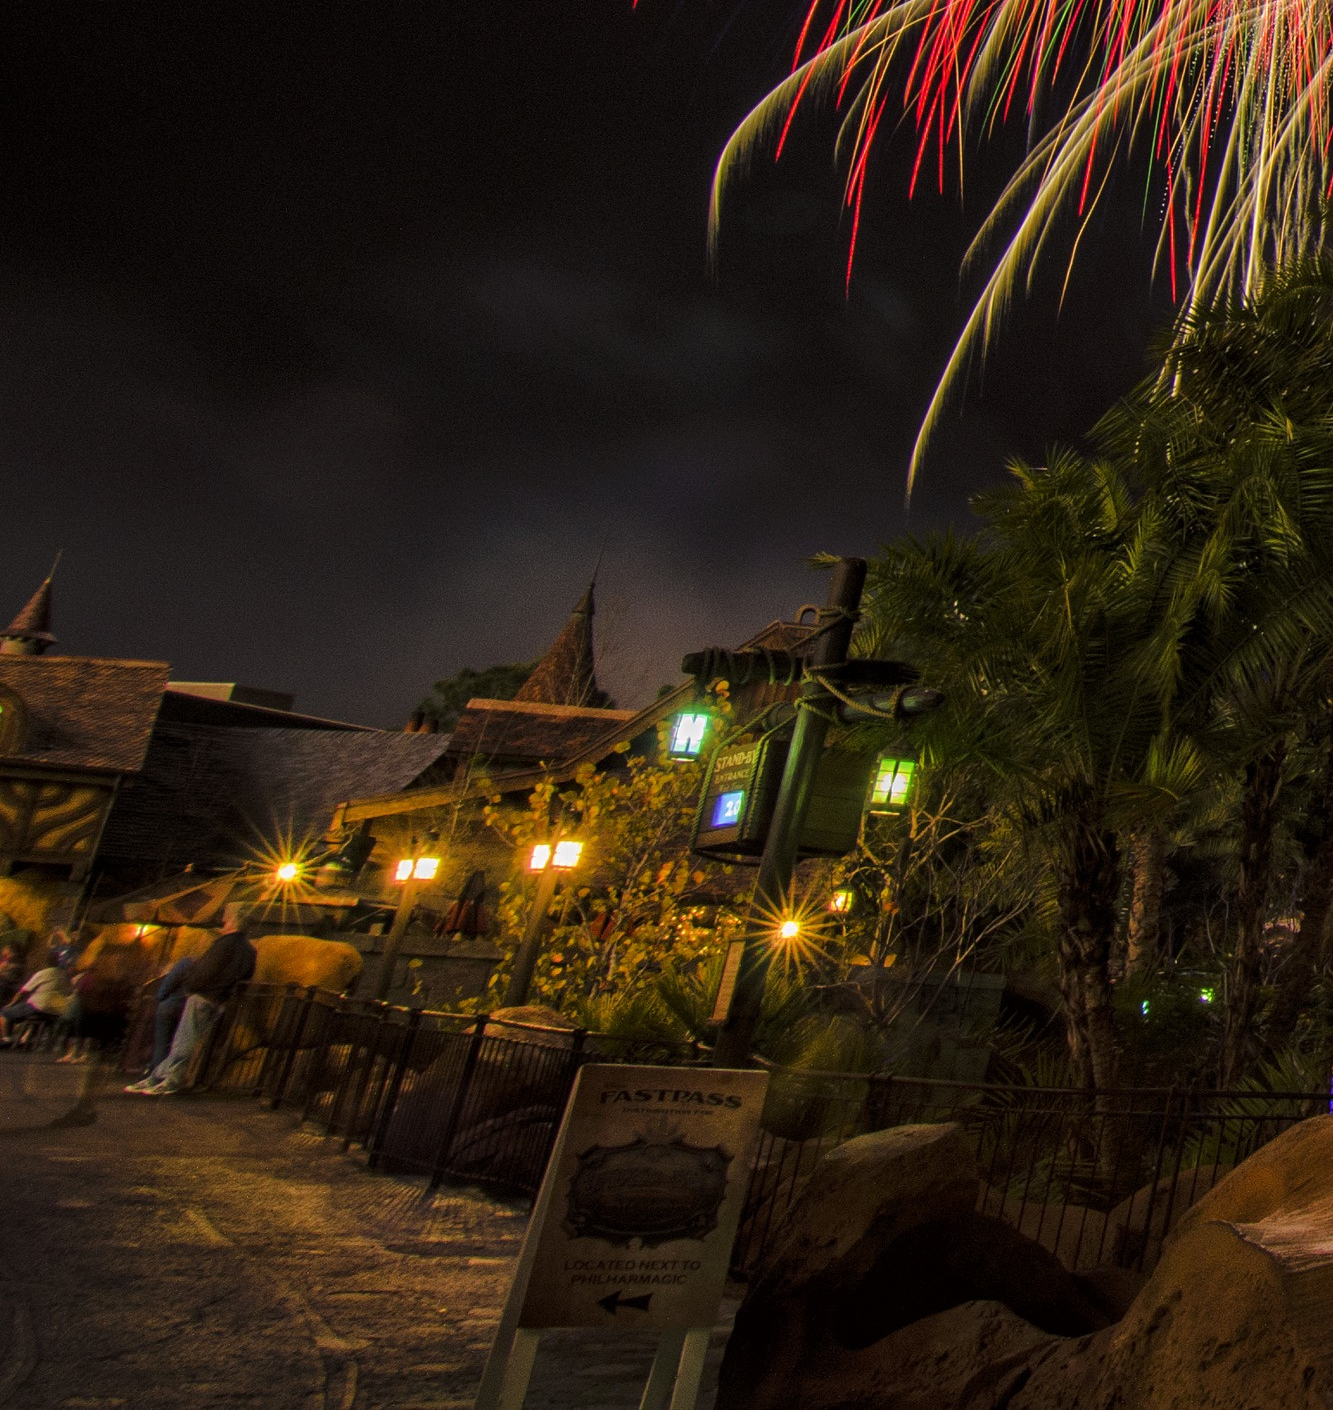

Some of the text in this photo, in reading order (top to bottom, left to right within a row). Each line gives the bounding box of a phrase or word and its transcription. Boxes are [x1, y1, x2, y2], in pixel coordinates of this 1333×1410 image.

[599, 1089, 742, 1109] FASTPASS
[564, 1259, 702, 1271] LOCATED NEXT TO
[570, 1274, 687, 1285] PHILHARMAGIC
